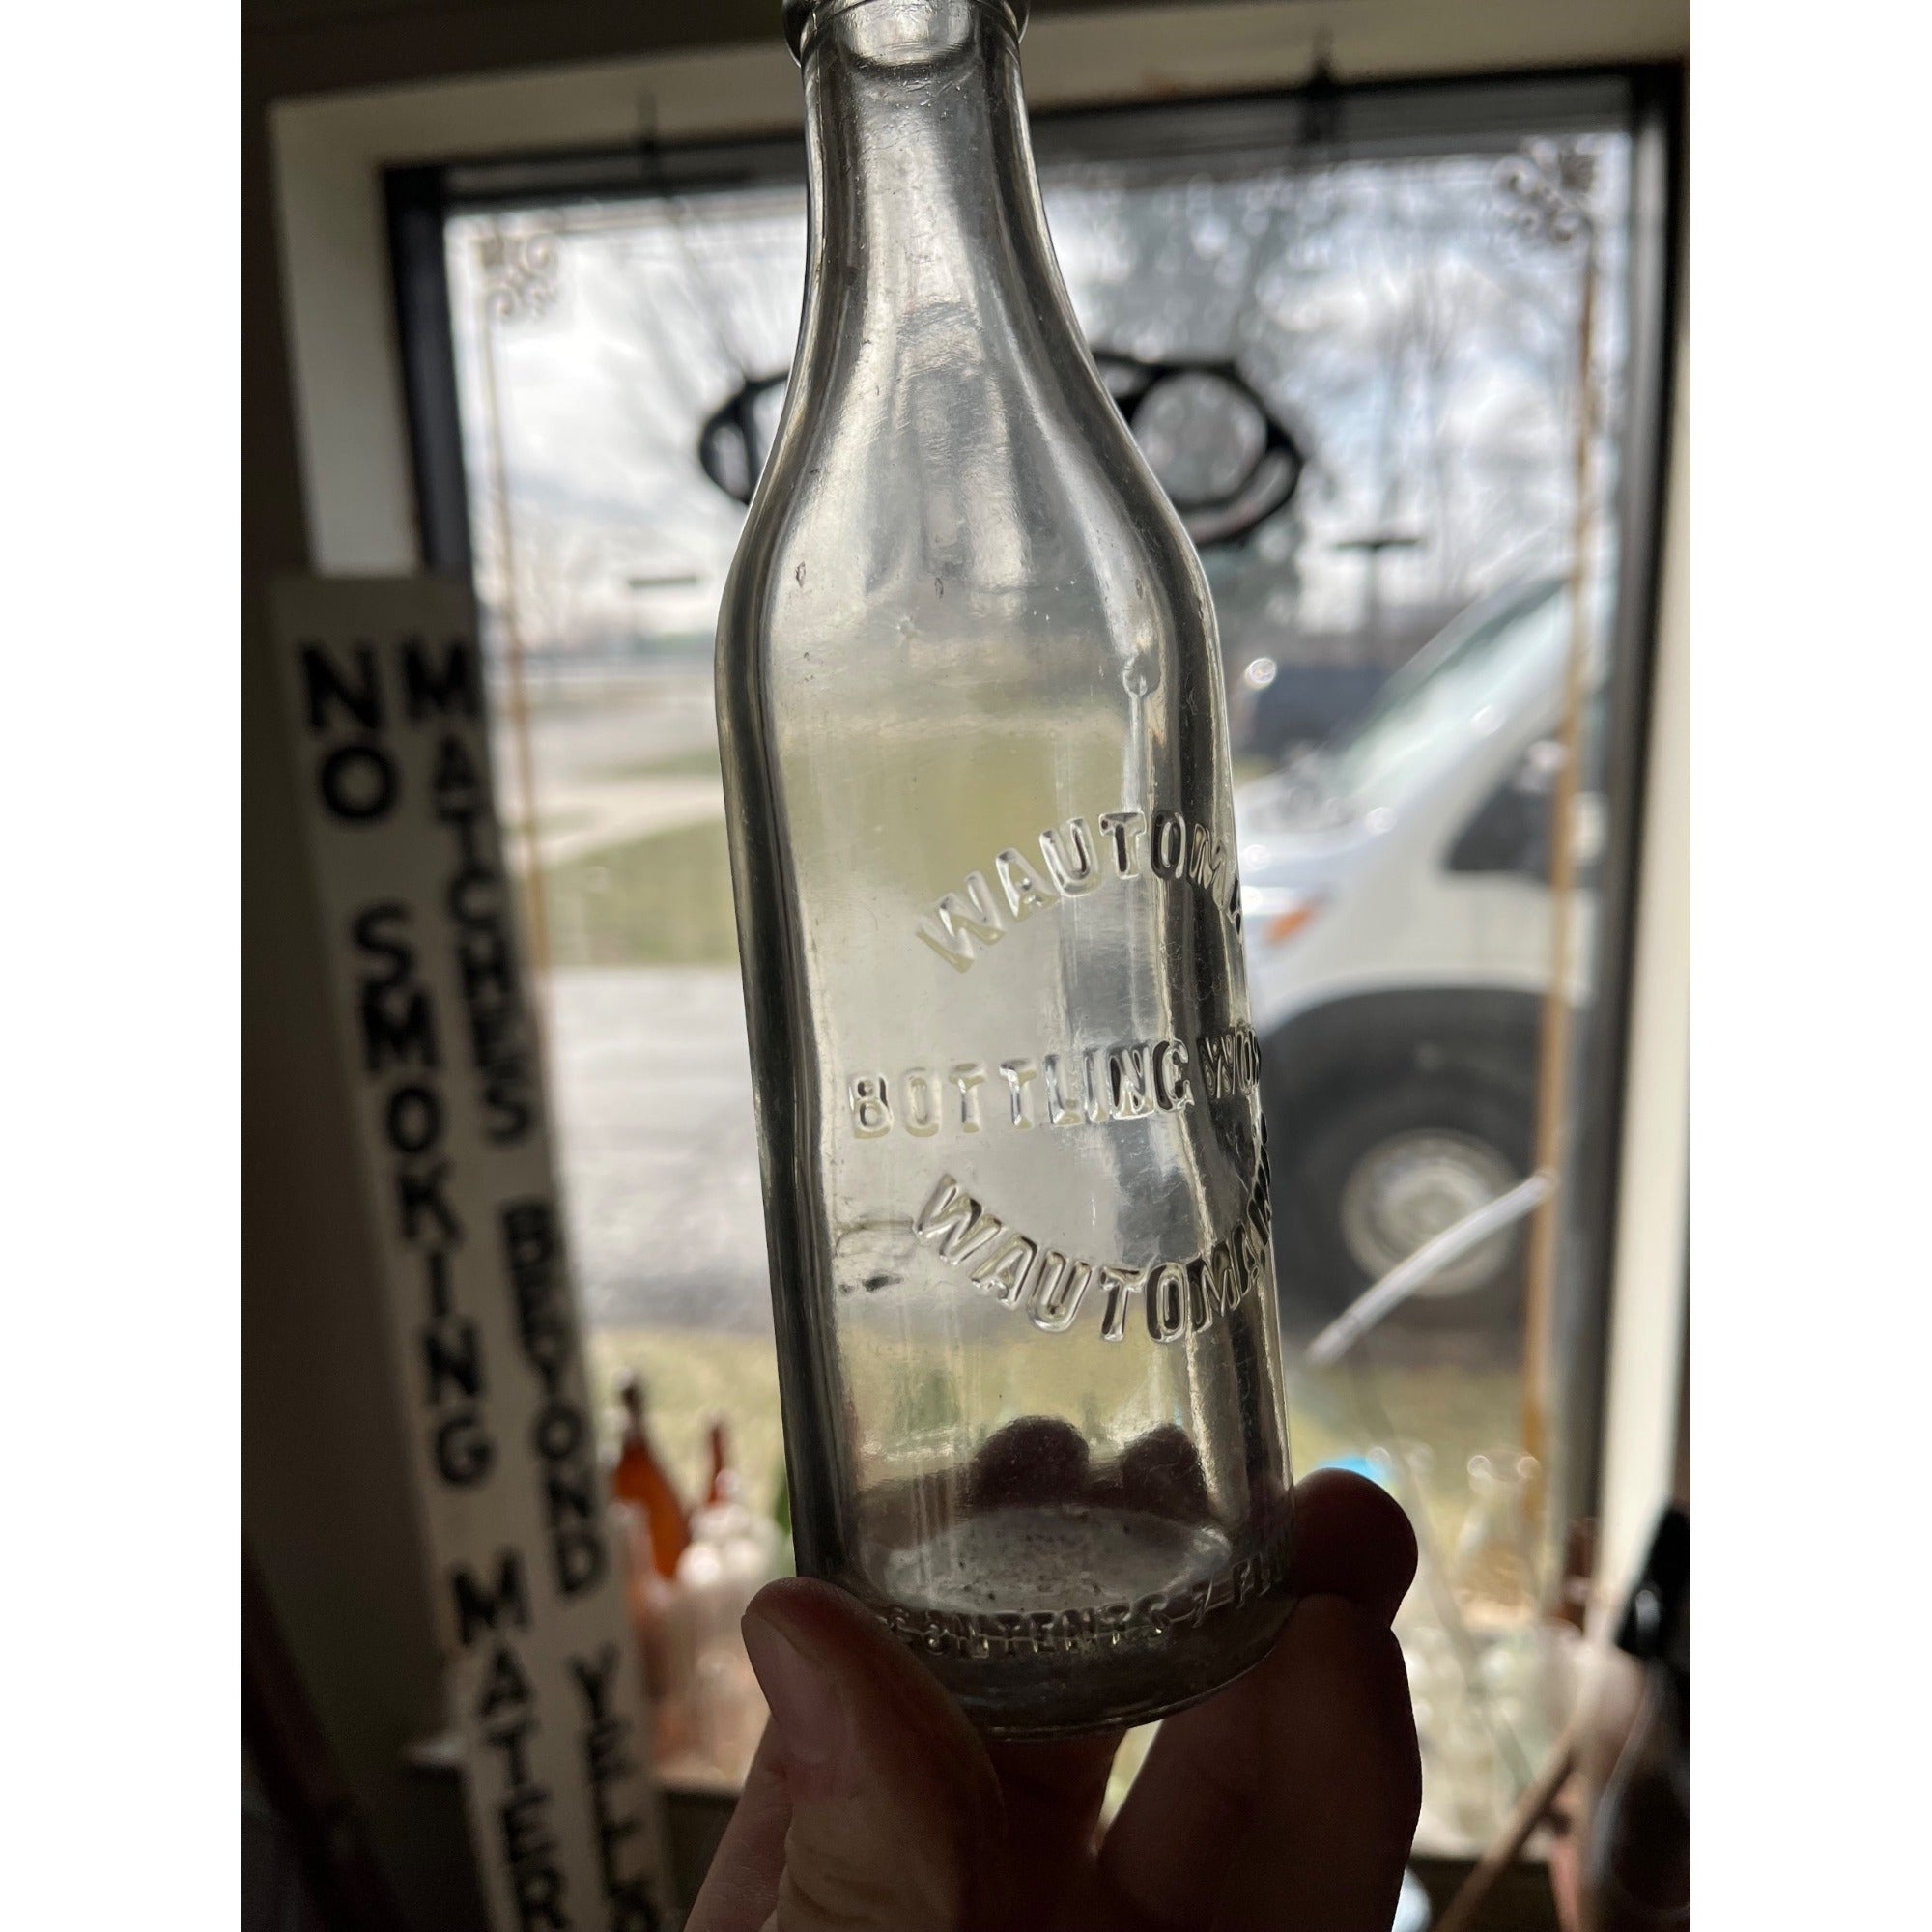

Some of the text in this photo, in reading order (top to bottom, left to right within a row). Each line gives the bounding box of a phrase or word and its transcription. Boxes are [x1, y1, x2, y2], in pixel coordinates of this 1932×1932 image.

[300, 639, 398, 823] NO
[352, 904, 493, 1486] SMOKING
[400, 638, 531, 1144] MATCHES
[500, 1204, 605, 1592] BEYOND
[849, 1038, 1194, 1139] BOTTLING
